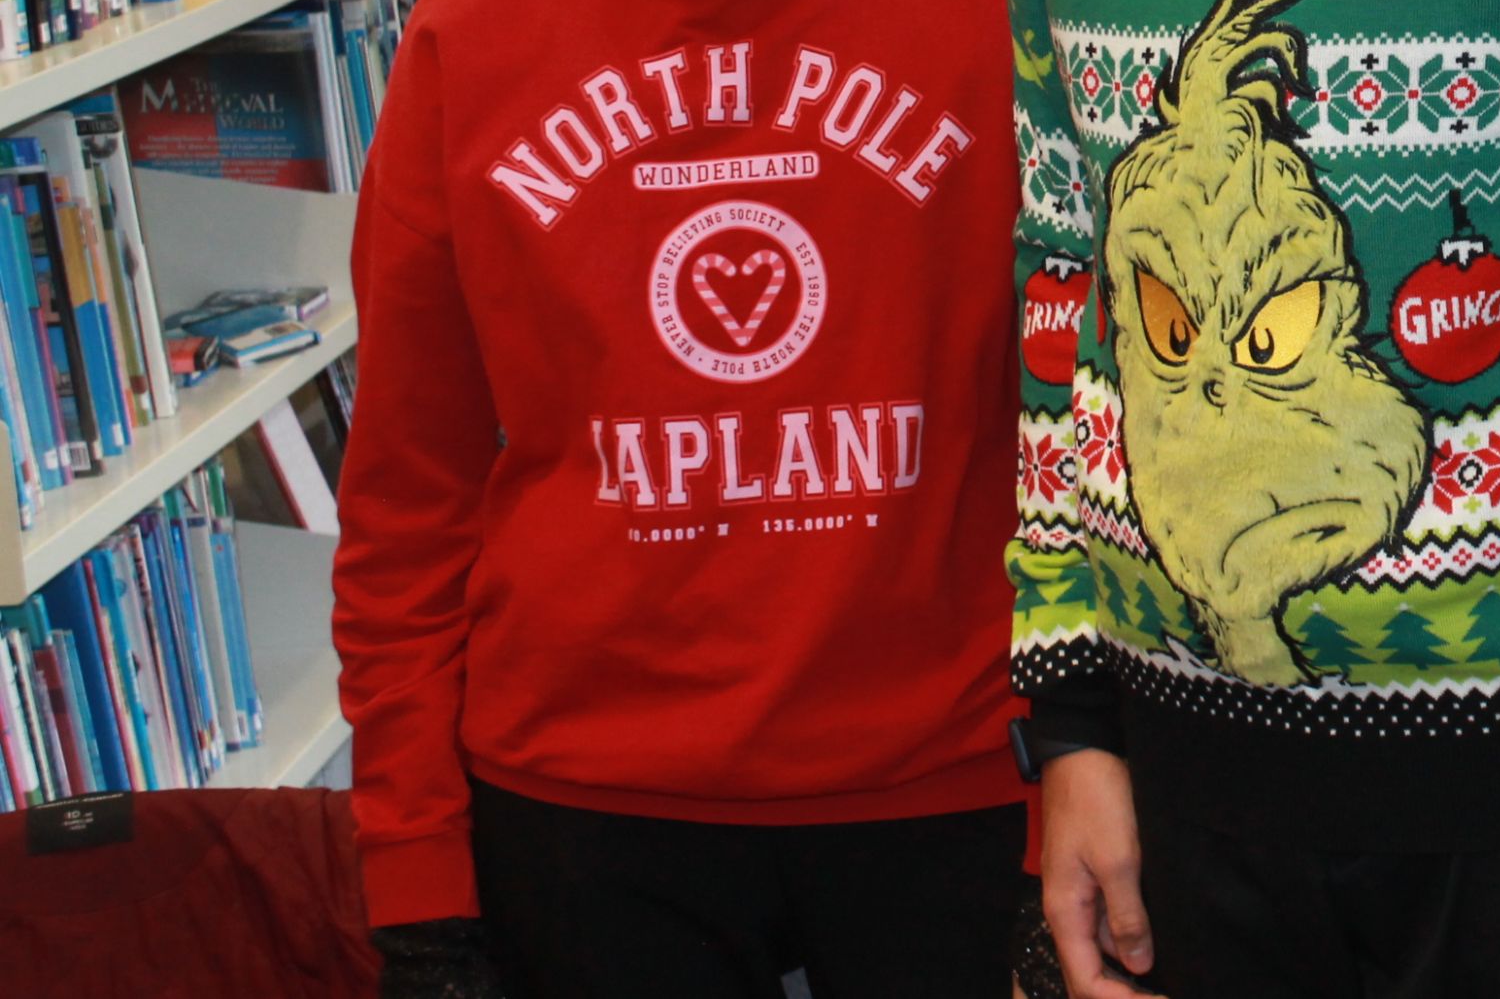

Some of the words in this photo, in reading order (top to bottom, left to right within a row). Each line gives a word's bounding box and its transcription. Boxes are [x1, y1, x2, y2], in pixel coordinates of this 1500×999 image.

[488, 40, 753, 230] NORTH
[772, 43, 975, 207] POLE
[638, 155, 815, 186] WONDERLAND
[729, 208, 787, 233] SOCIETY
[662, 211, 723, 267] BELIEVING
[795, 242, 815, 268] EST
[656, 272, 670, 308] STOP
[807, 275, 820, 307] 1990
[661, 314, 696, 358] NEVER
[794, 314, 815, 342] THE
[711, 358, 745, 375] POLE
[753, 341, 796, 373] NORTH
[590, 402, 925, 512] LAPLAND
